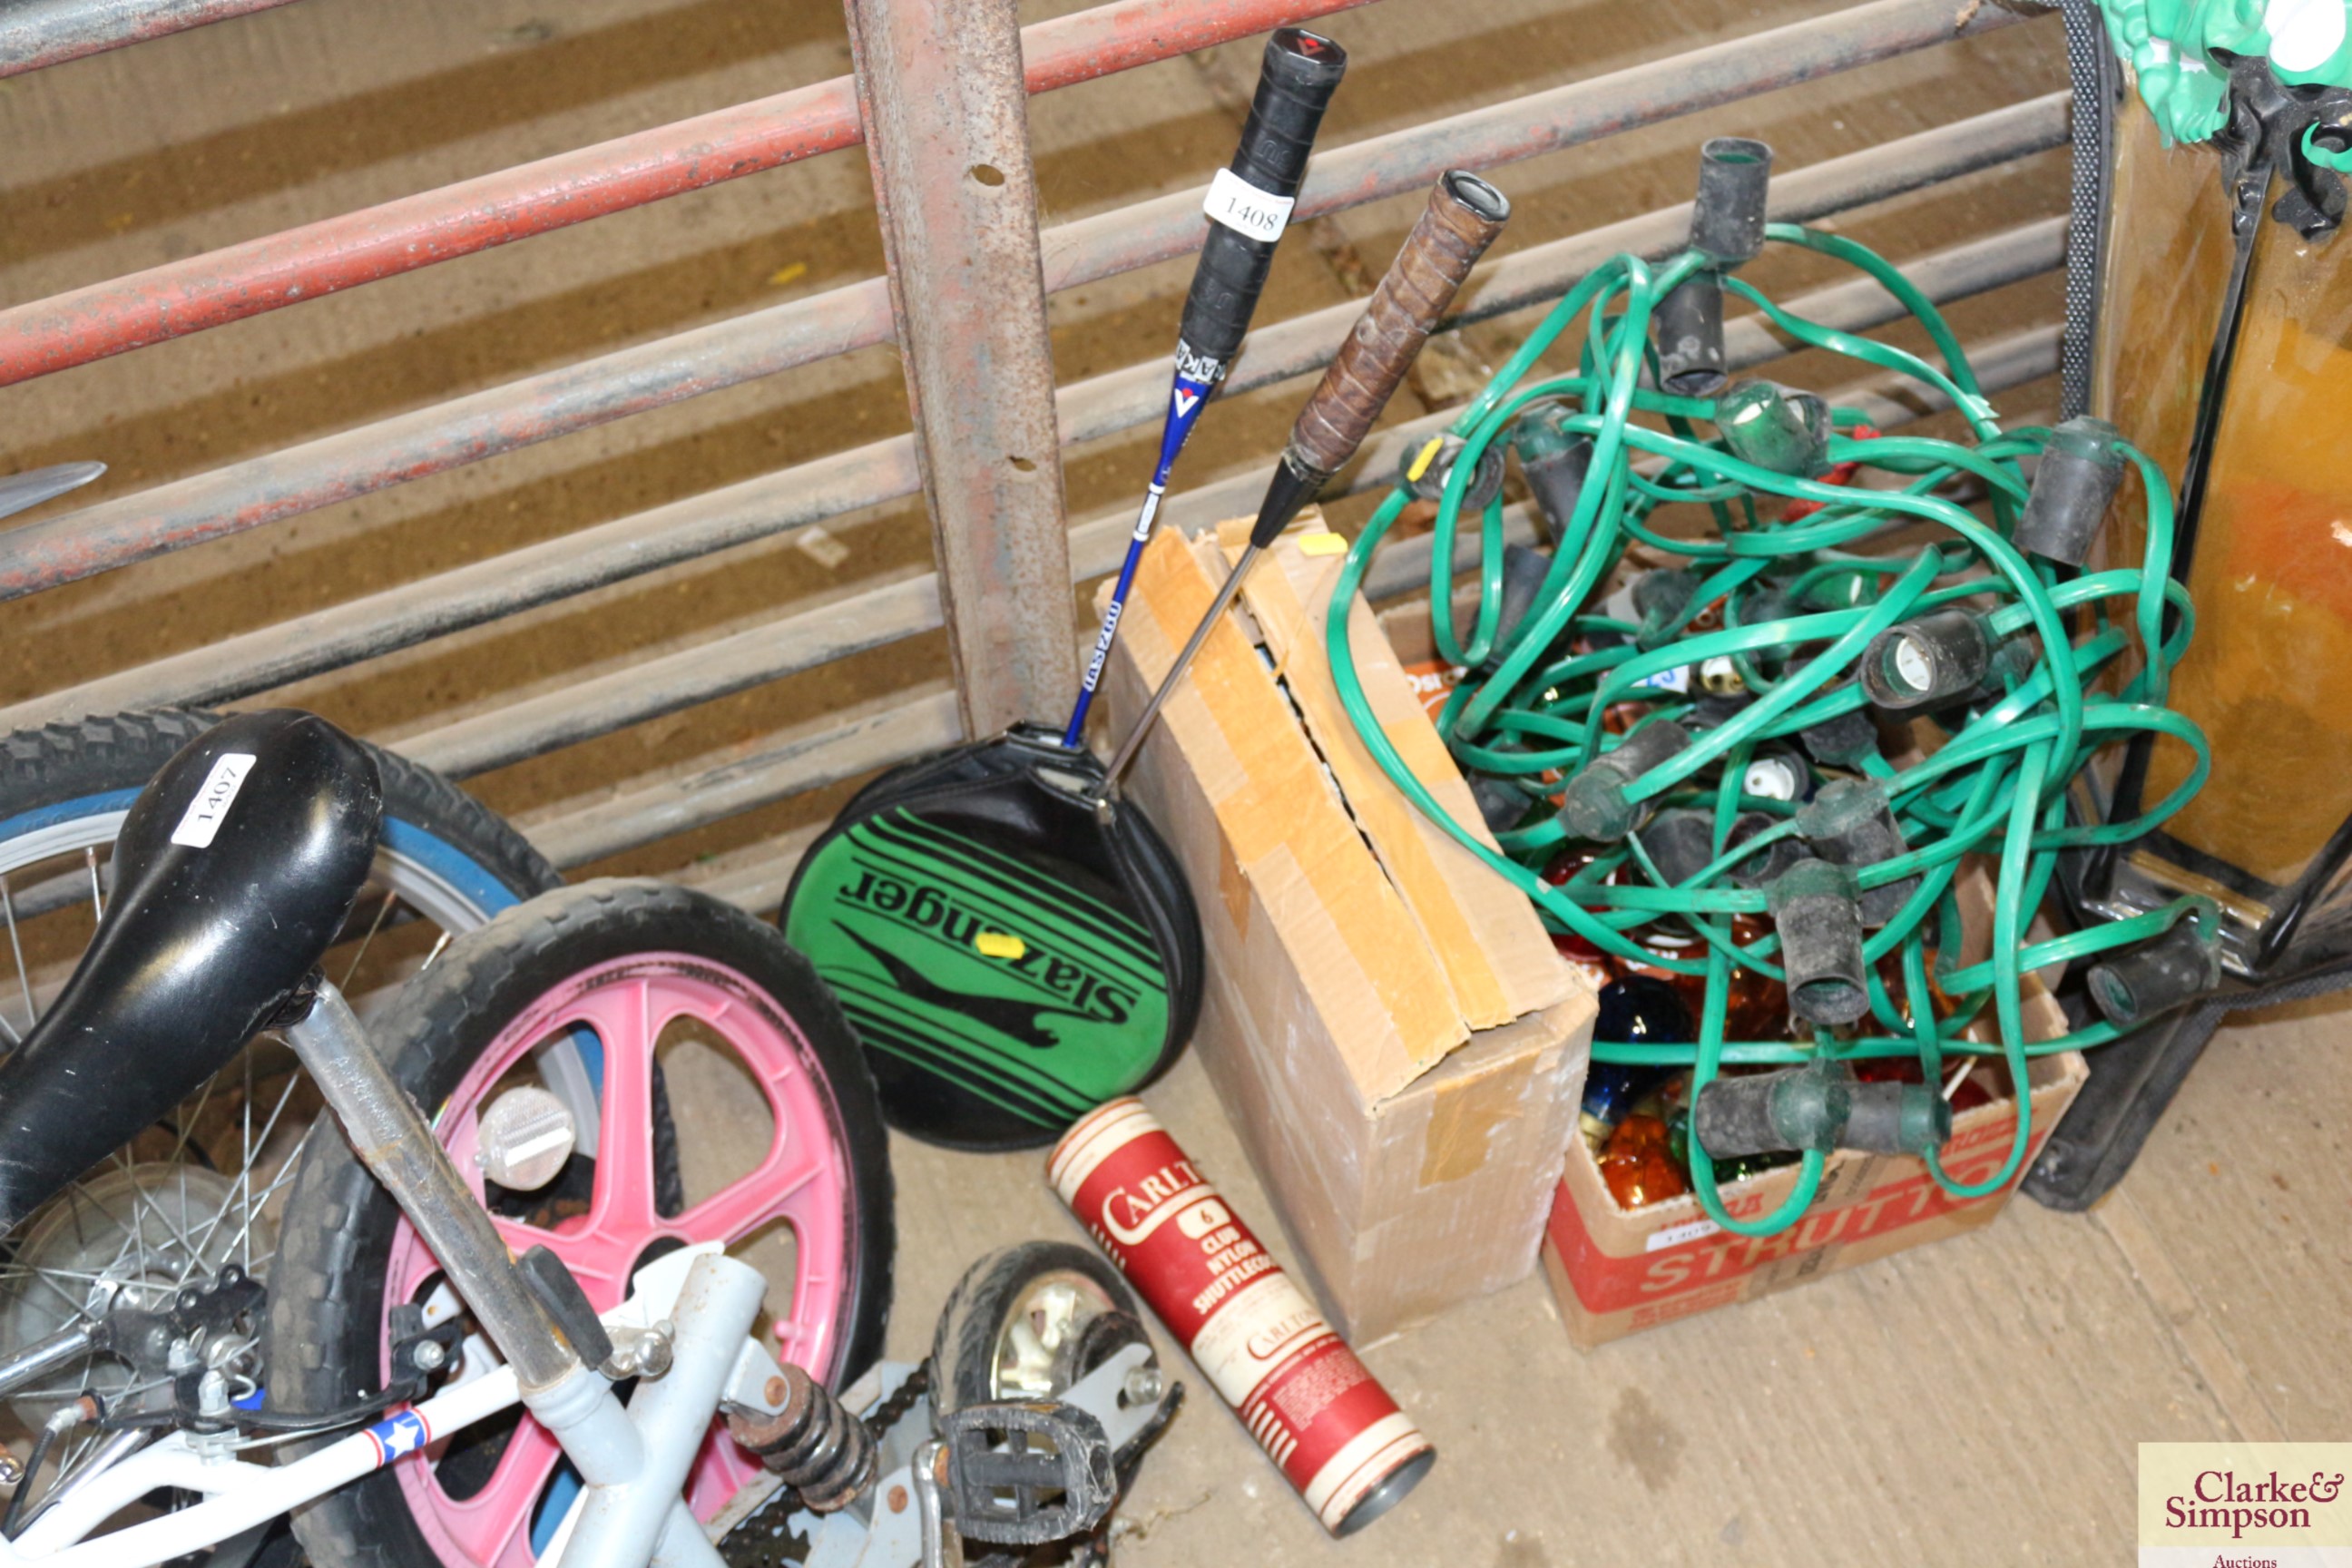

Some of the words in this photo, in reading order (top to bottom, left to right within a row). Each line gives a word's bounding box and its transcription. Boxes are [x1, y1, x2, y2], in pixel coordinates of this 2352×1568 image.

[1226, 196, 1279, 231] 1408
[197, 766, 237, 823] 1407
[839, 868, 1142, 1026] Slaznger
[1102, 1160, 1205, 1245] CARLT
[1200, 1209, 1214, 1224] 6
[1639, 1159, 2006, 1293] STRUTTO
[1200, 1225, 1241, 1255] CLUB
[1206, 1239, 1259, 1276] NYLON
[1192, 1253, 1276, 1316] SHUTTLECO
